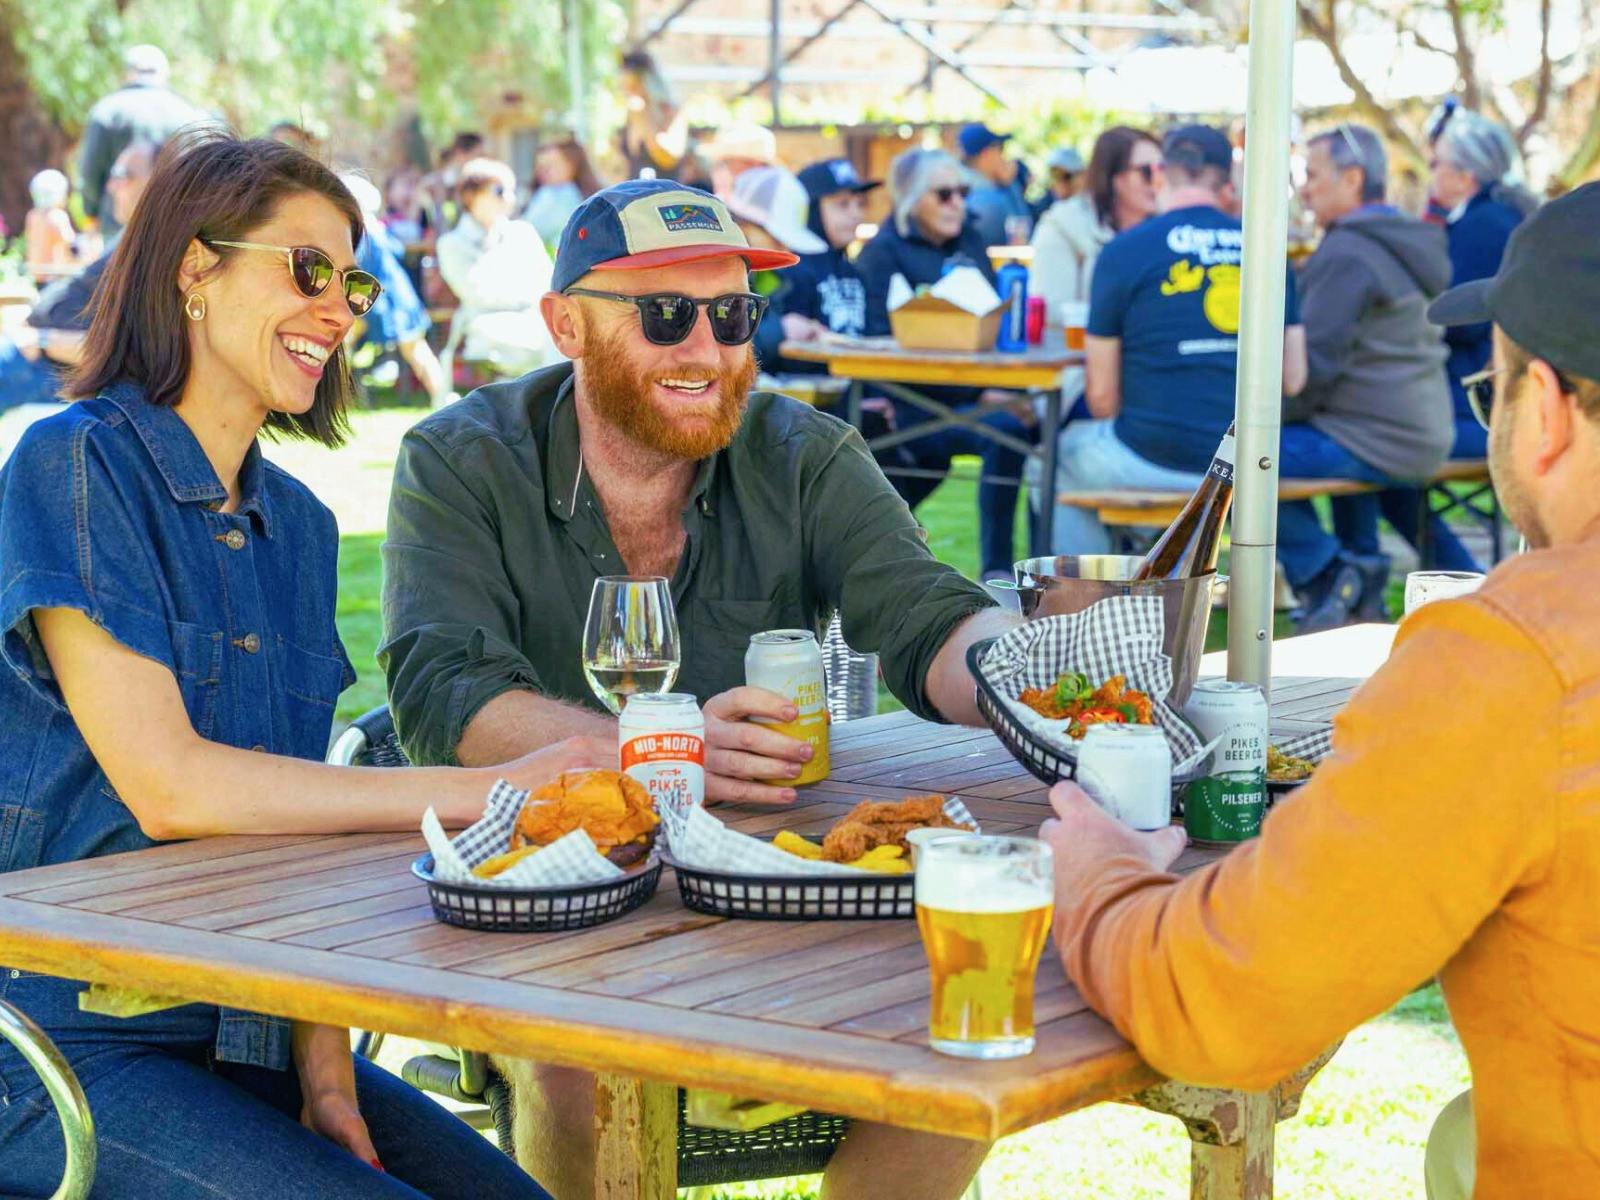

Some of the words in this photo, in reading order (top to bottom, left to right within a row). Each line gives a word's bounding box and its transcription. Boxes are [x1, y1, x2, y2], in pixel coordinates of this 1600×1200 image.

[668, 222, 720, 230] PASSENGER
[633, 736, 700, 755] MID-NORTH
[1231, 738, 1259, 749] PIKES
[1225, 750, 1250, 761] BEER
[649, 779, 687, 792] PIKES
[1221, 792, 1262, 805] PILSENER
